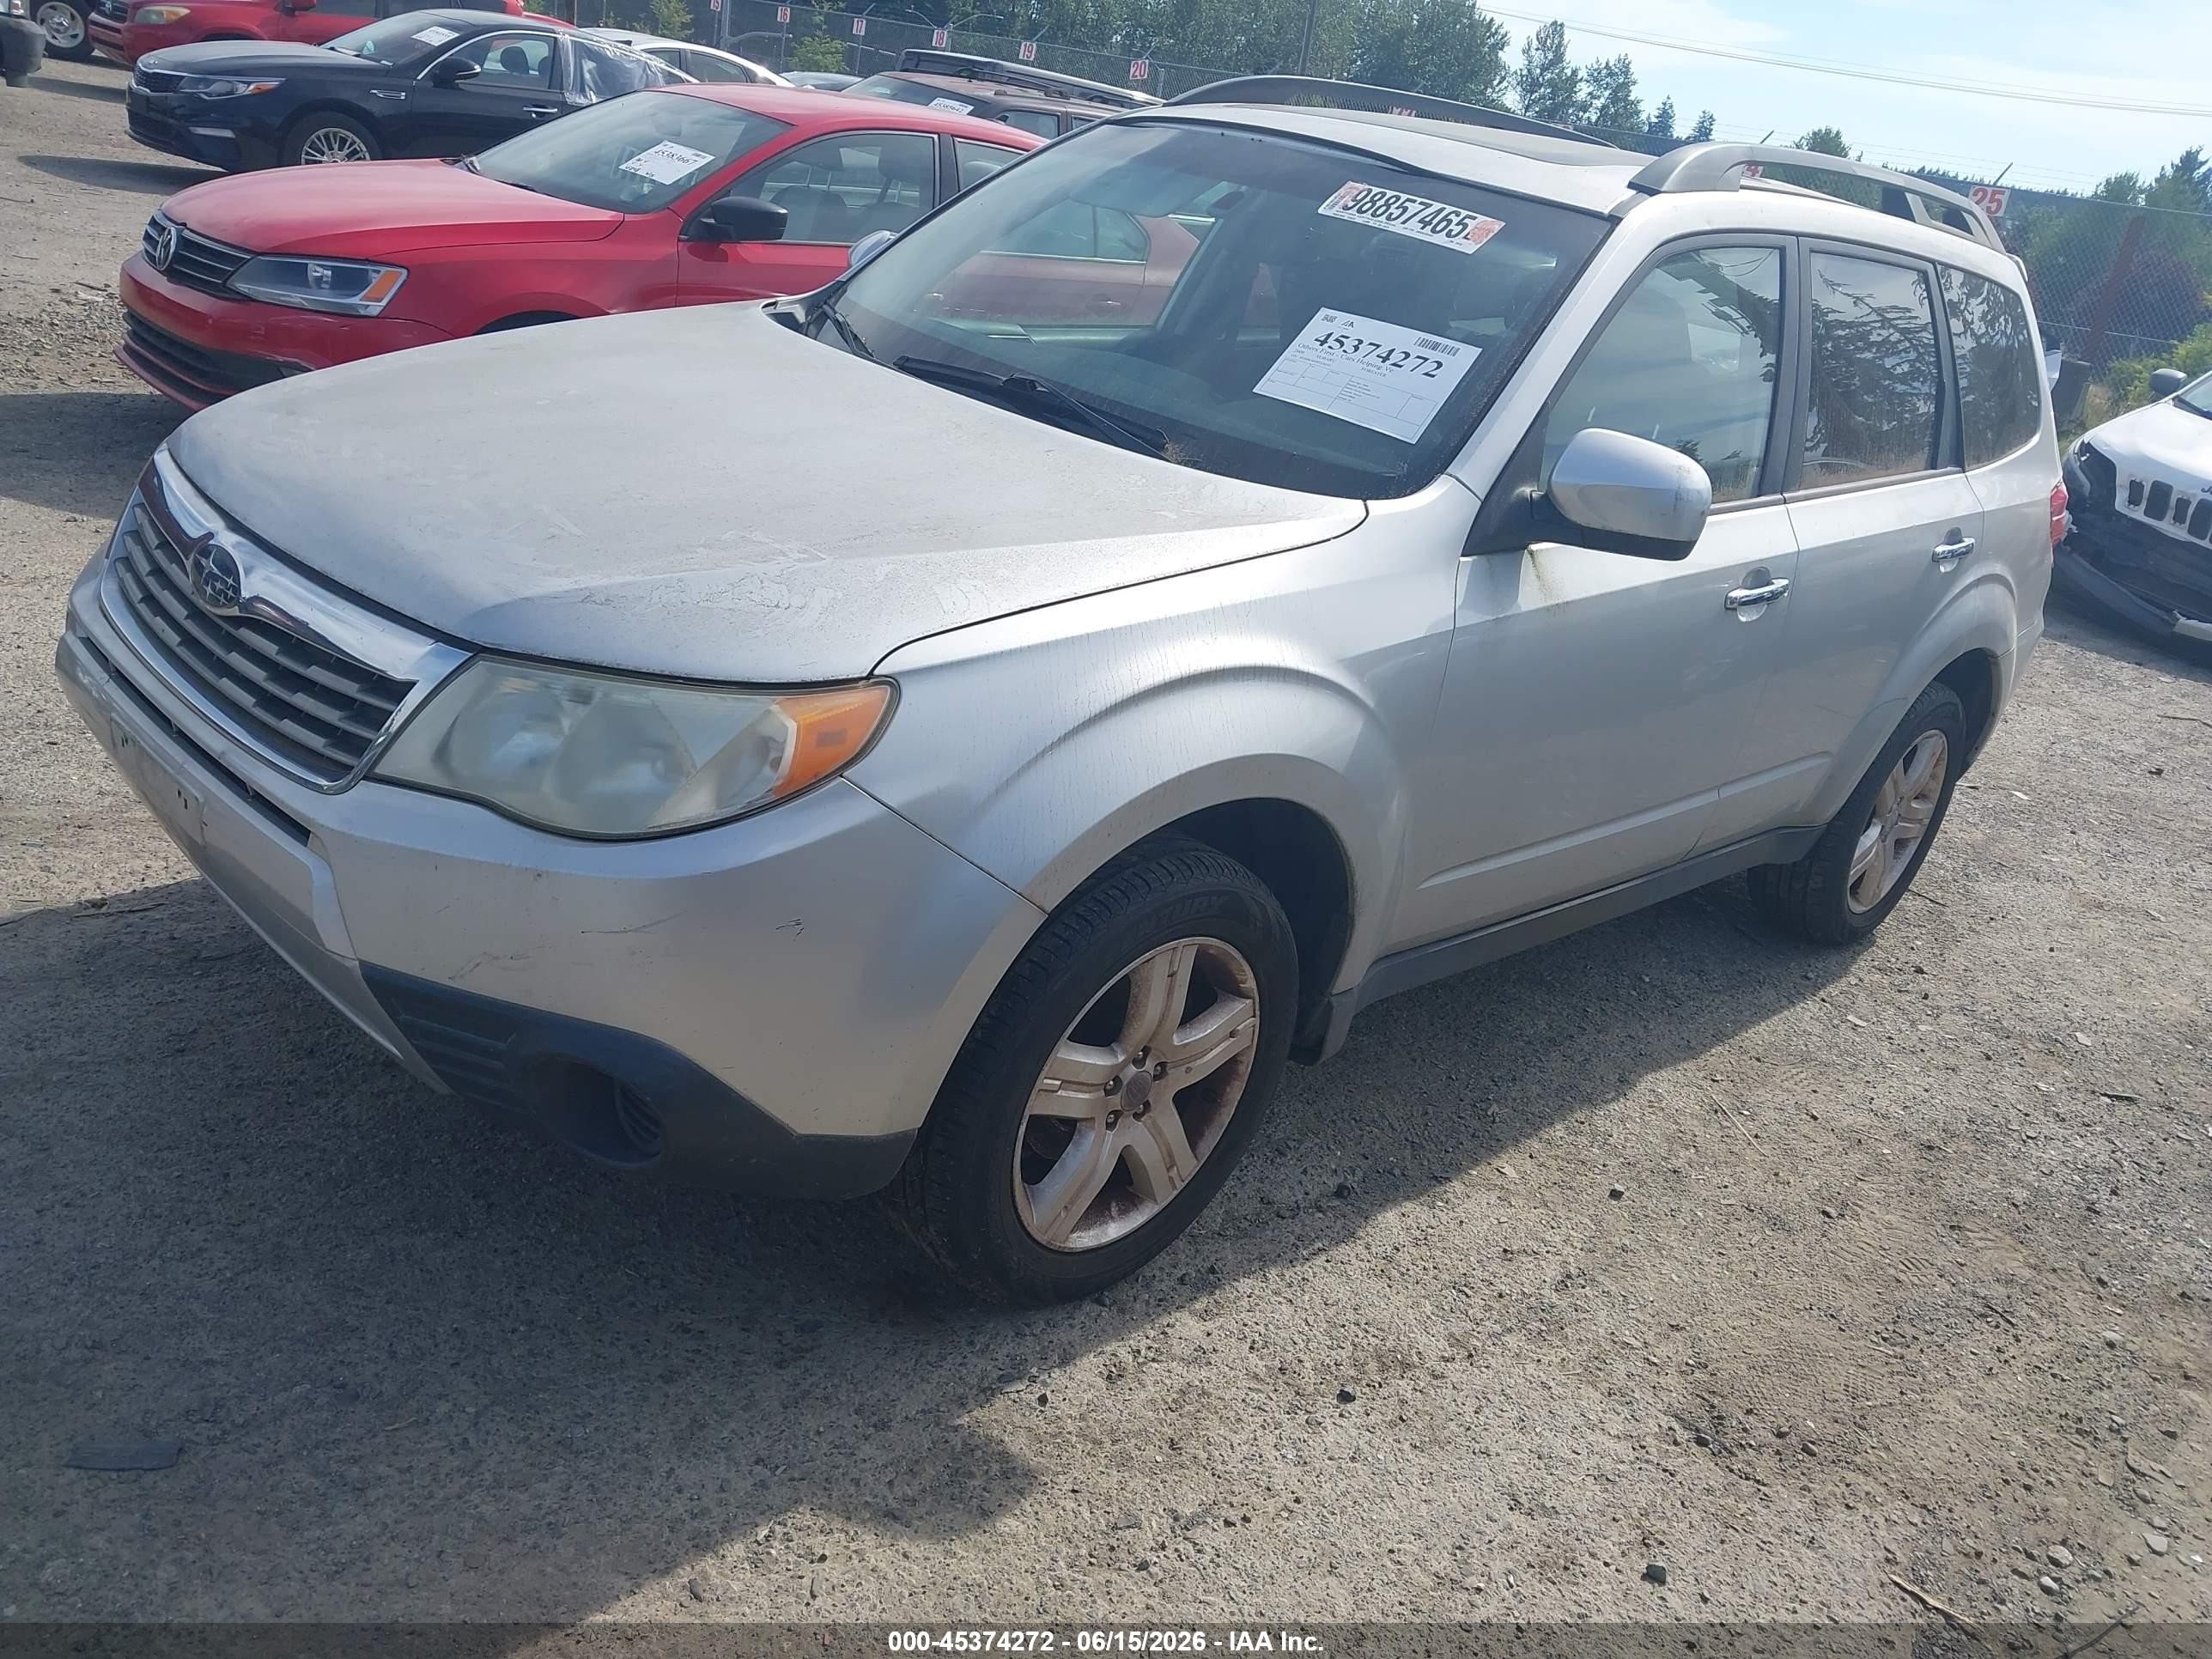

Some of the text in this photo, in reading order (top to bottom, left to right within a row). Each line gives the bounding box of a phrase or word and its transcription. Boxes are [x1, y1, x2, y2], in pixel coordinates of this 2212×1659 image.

[779, 7, 789, 20] 16
[854, 19, 865, 33] 17
[934, 30, 945, 46] 18
[1022, 42, 1034, 59] 19
[1132, 61, 1147, 78] 20
[1972, 186, 2007, 216] 25
[1341, 187, 1477, 239] 98857465
[1297, 343, 1319, 353] Others
[1319, 348, 1334, 357] First
[1340, 353, 1356, 363] Cars
[1356, 357, 1383, 372] Helping
[1314, 331, 1443, 379] 45374272
